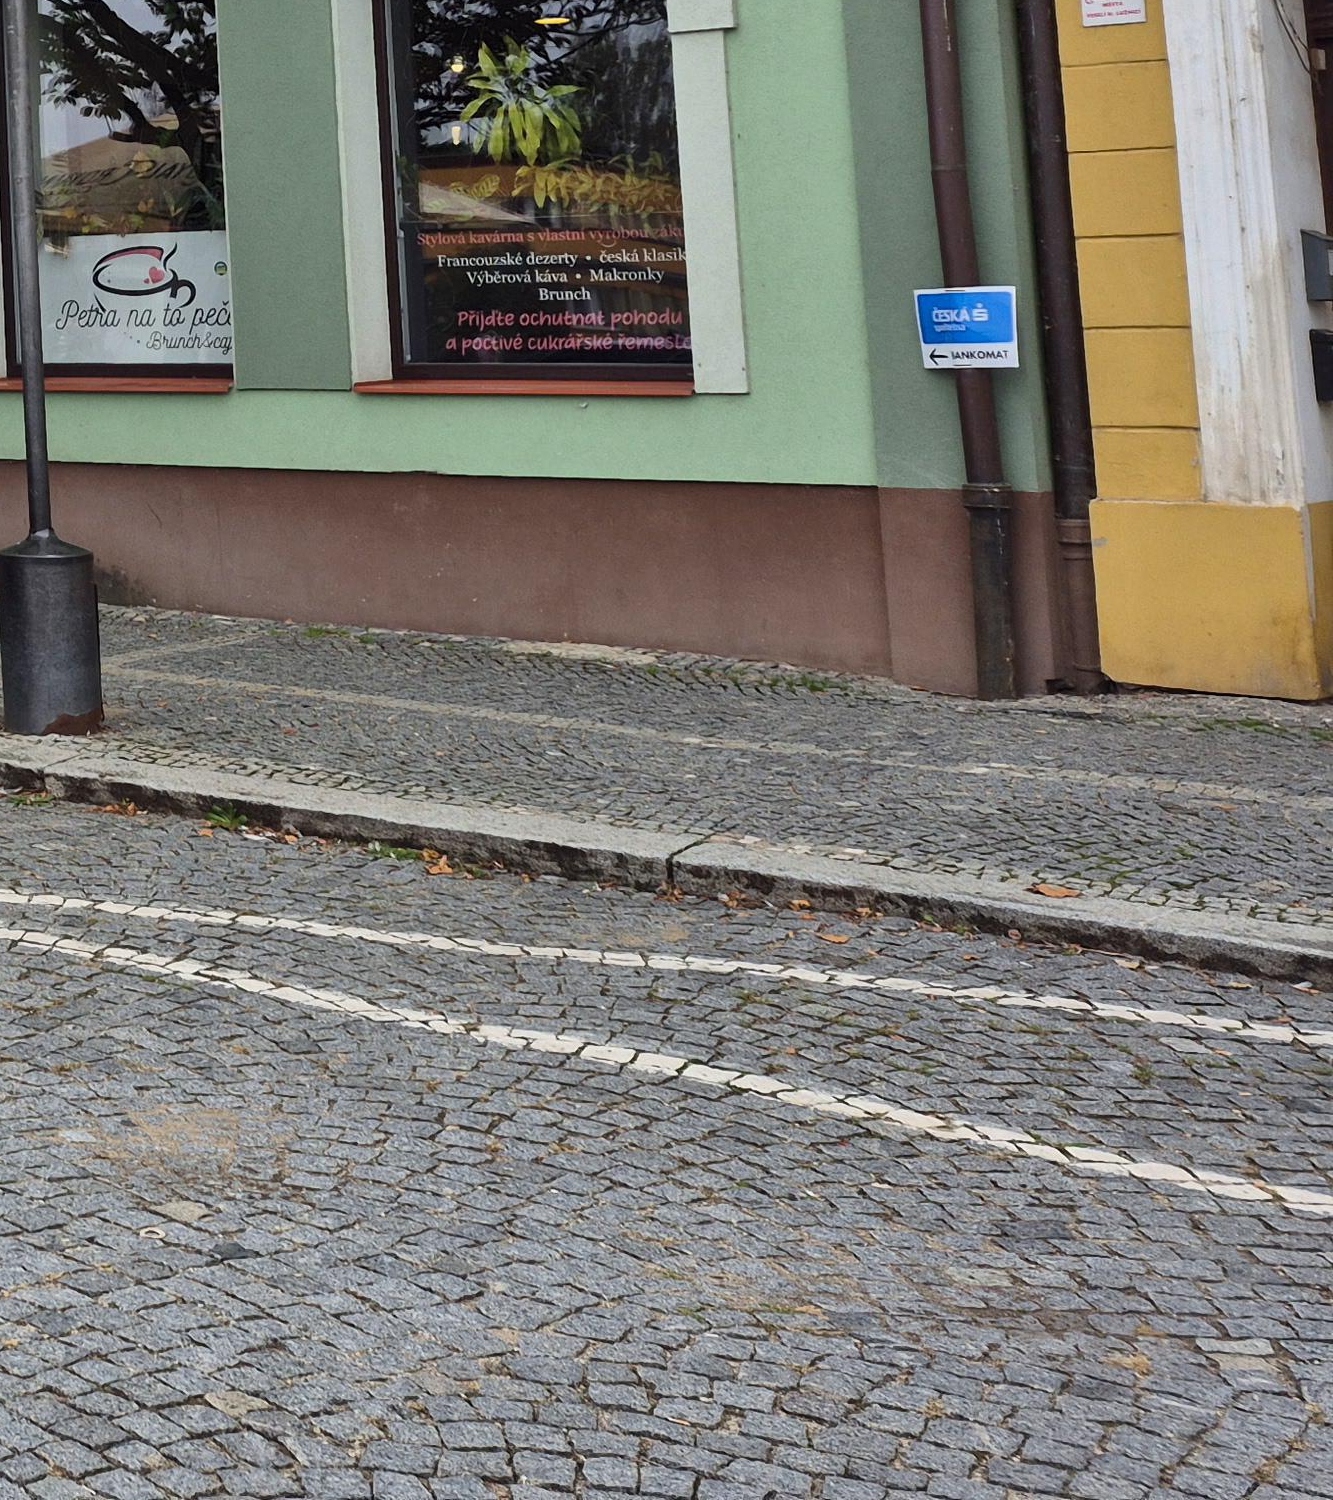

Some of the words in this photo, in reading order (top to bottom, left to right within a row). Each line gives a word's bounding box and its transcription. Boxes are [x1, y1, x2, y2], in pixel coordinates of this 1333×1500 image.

[417, 231, 466, 247] Stylová
[469, 229, 523, 244] kavárna
[526, 233, 534, 242] s
[437, 251, 523, 268] Francouzské
[526, 251, 579, 268] dezerty
[599, 248, 639, 263] česká
[643, 247, 686, 263] klasik
[466, 268, 532, 288] Výběrová
[535, 268, 568, 283] káva
[589, 266, 665, 284] Makronky
[538, 286, 592, 301] Brunch
[55, 299, 120, 331] Petra
[126, 308, 156, 328] na
[162, 302, 186, 328] to
[457, 309, 515, 332] Přijďte
[519, 310, 606, 328] ochutnat
[610, 307, 683, 333] pohodu
[445, 339, 457, 351] a
[461, 333, 523, 357] poctivé
[527, 333, 613, 352] cukrářské
